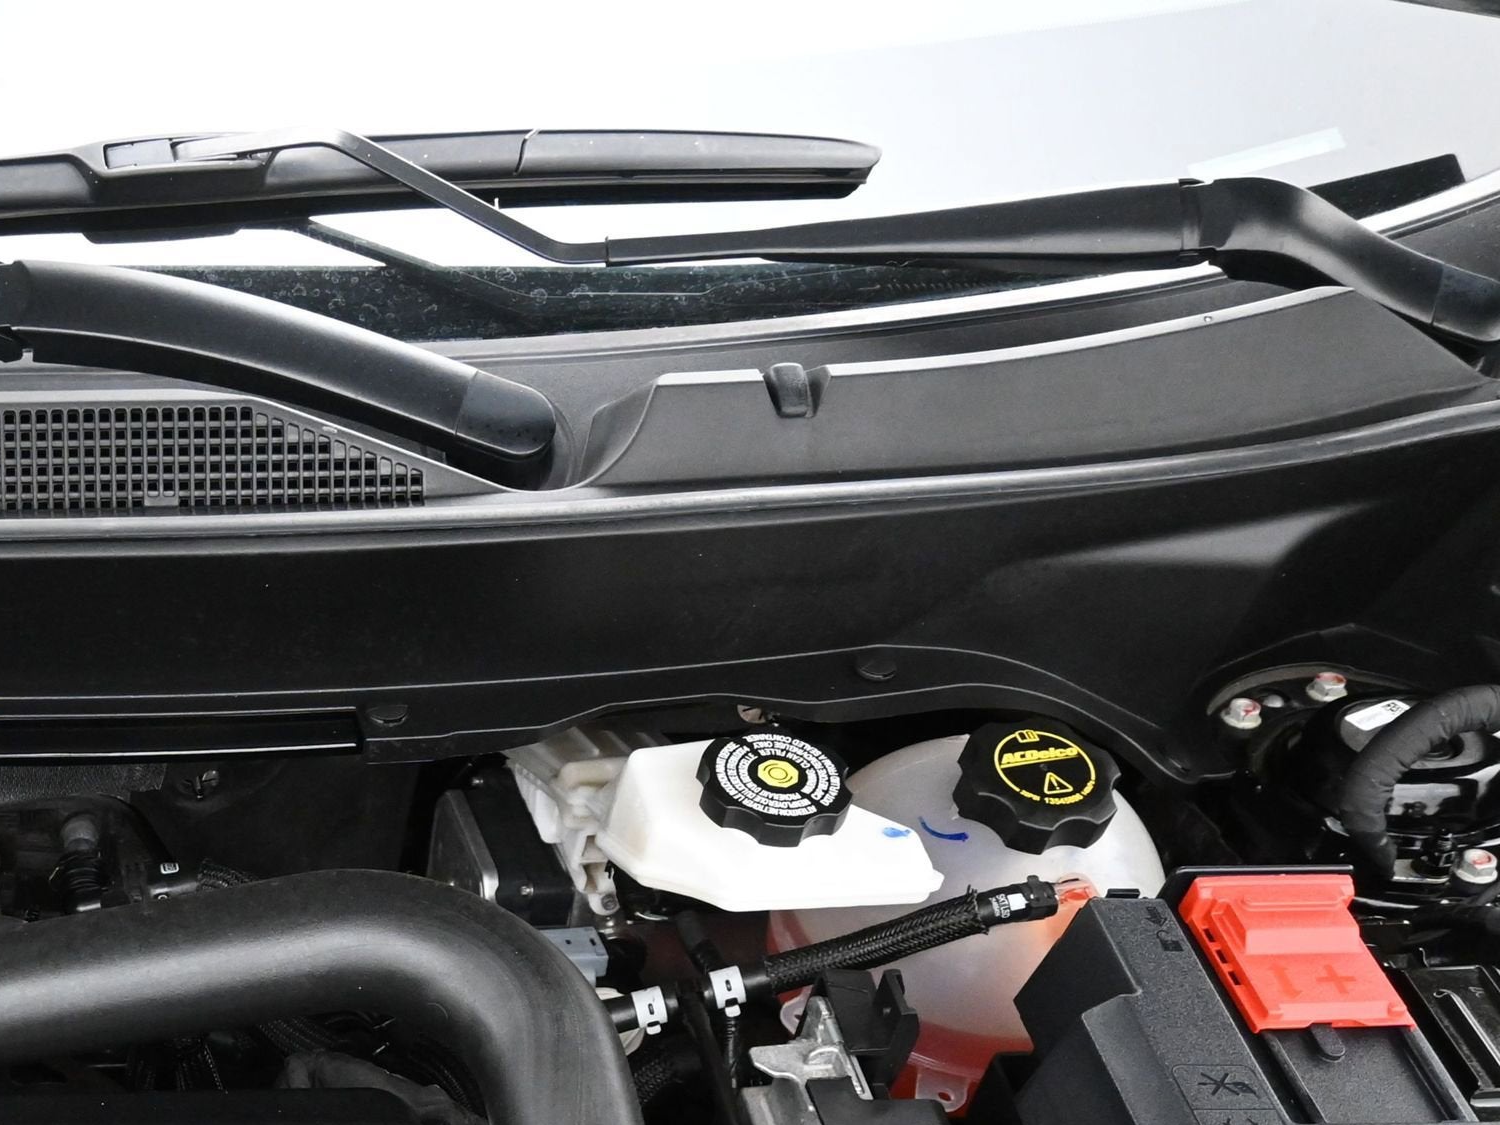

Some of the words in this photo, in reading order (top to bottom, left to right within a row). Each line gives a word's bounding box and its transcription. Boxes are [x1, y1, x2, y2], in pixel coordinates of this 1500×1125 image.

[753, 742, 773, 750] ONLY
[758, 749, 786, 757] FILLER
[791, 739, 822, 757] SEALED
[786, 752, 811, 768] CLEAN
[1002, 747, 1079, 765] ACDelco
[819, 759, 838, 775] FROM
[829, 776, 840, 792] FLUID
[733, 793, 745, 802] LE
[820, 794, 835, 806] DOT
